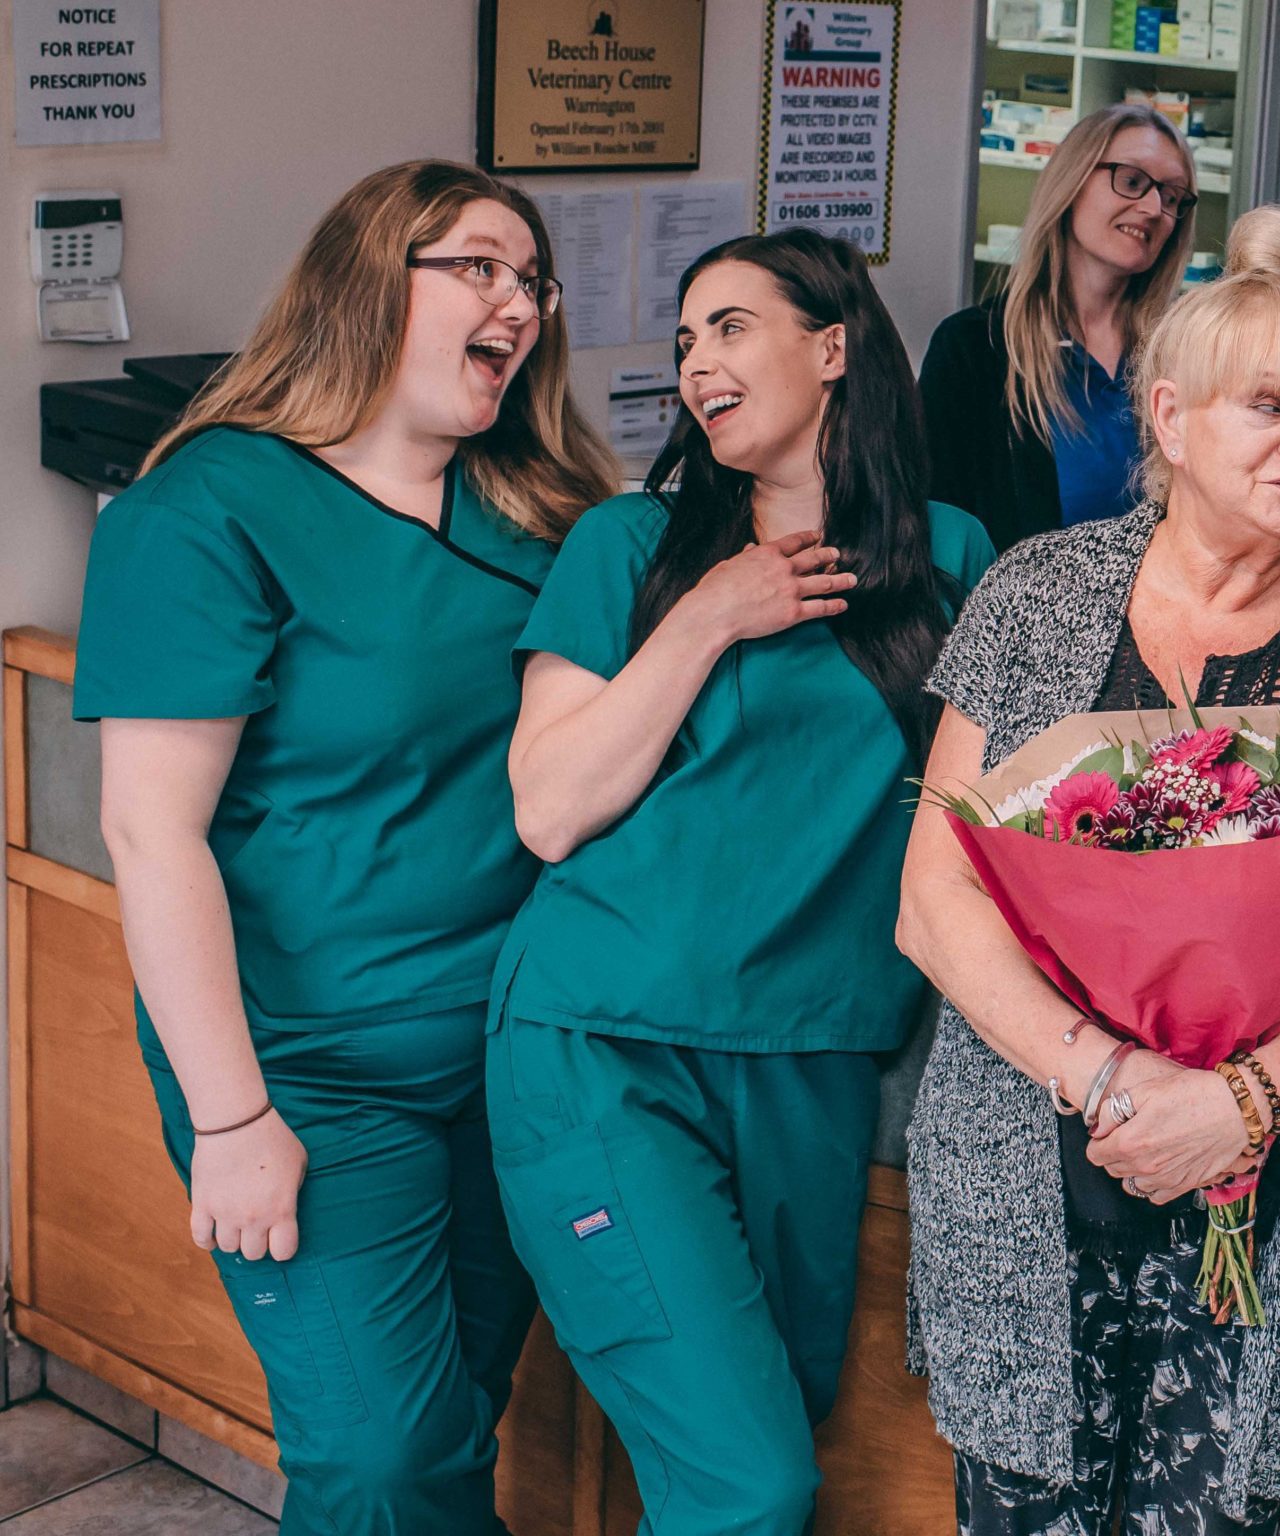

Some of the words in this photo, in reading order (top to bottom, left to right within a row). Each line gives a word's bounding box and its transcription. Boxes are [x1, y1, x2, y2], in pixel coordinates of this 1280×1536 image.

[58, 8, 117, 25] NOTICE
[832, 12, 867, 23] Willows
[826, 25, 872, 37] Veterinary
[40, 42, 73, 57] FOR
[77, 41, 135, 57] REPEAT
[547, 39, 599, 61] Beech
[604, 40, 657, 61] House
[834, 36, 862, 48] Group
[30, 72, 147, 90] PRESCRIPTIONS
[527, 67, 613, 95] Veterinary
[618, 69, 672, 90] Centre
[782, 66, 881, 88] WARNING
[564, 97, 635, 117] Warrington
[781, 95, 811, 109] THESE
[813, 95, 859, 108] PREMISES
[861, 95, 880, 108] ARE
[43, 105, 98, 121] THANK
[101, 103, 135, 119] YOU
[780, 113, 836, 127] PROTECTED
[838, 113, 851, 127] BY
[530, 122, 571, 138] Opened
[785, 133, 803, 146] ALL
[806, 132, 835, 145] VIDEO
[837, 132, 872, 145] IMAGES
[780, 151, 800, 164] ARE
[802, 151, 854, 164] RECORDED
[856, 150, 876, 163] AND
[774, 170, 831, 183] MONITORED
[779, 204, 820, 220] 01606
[825, 203, 873, 218] 339900
